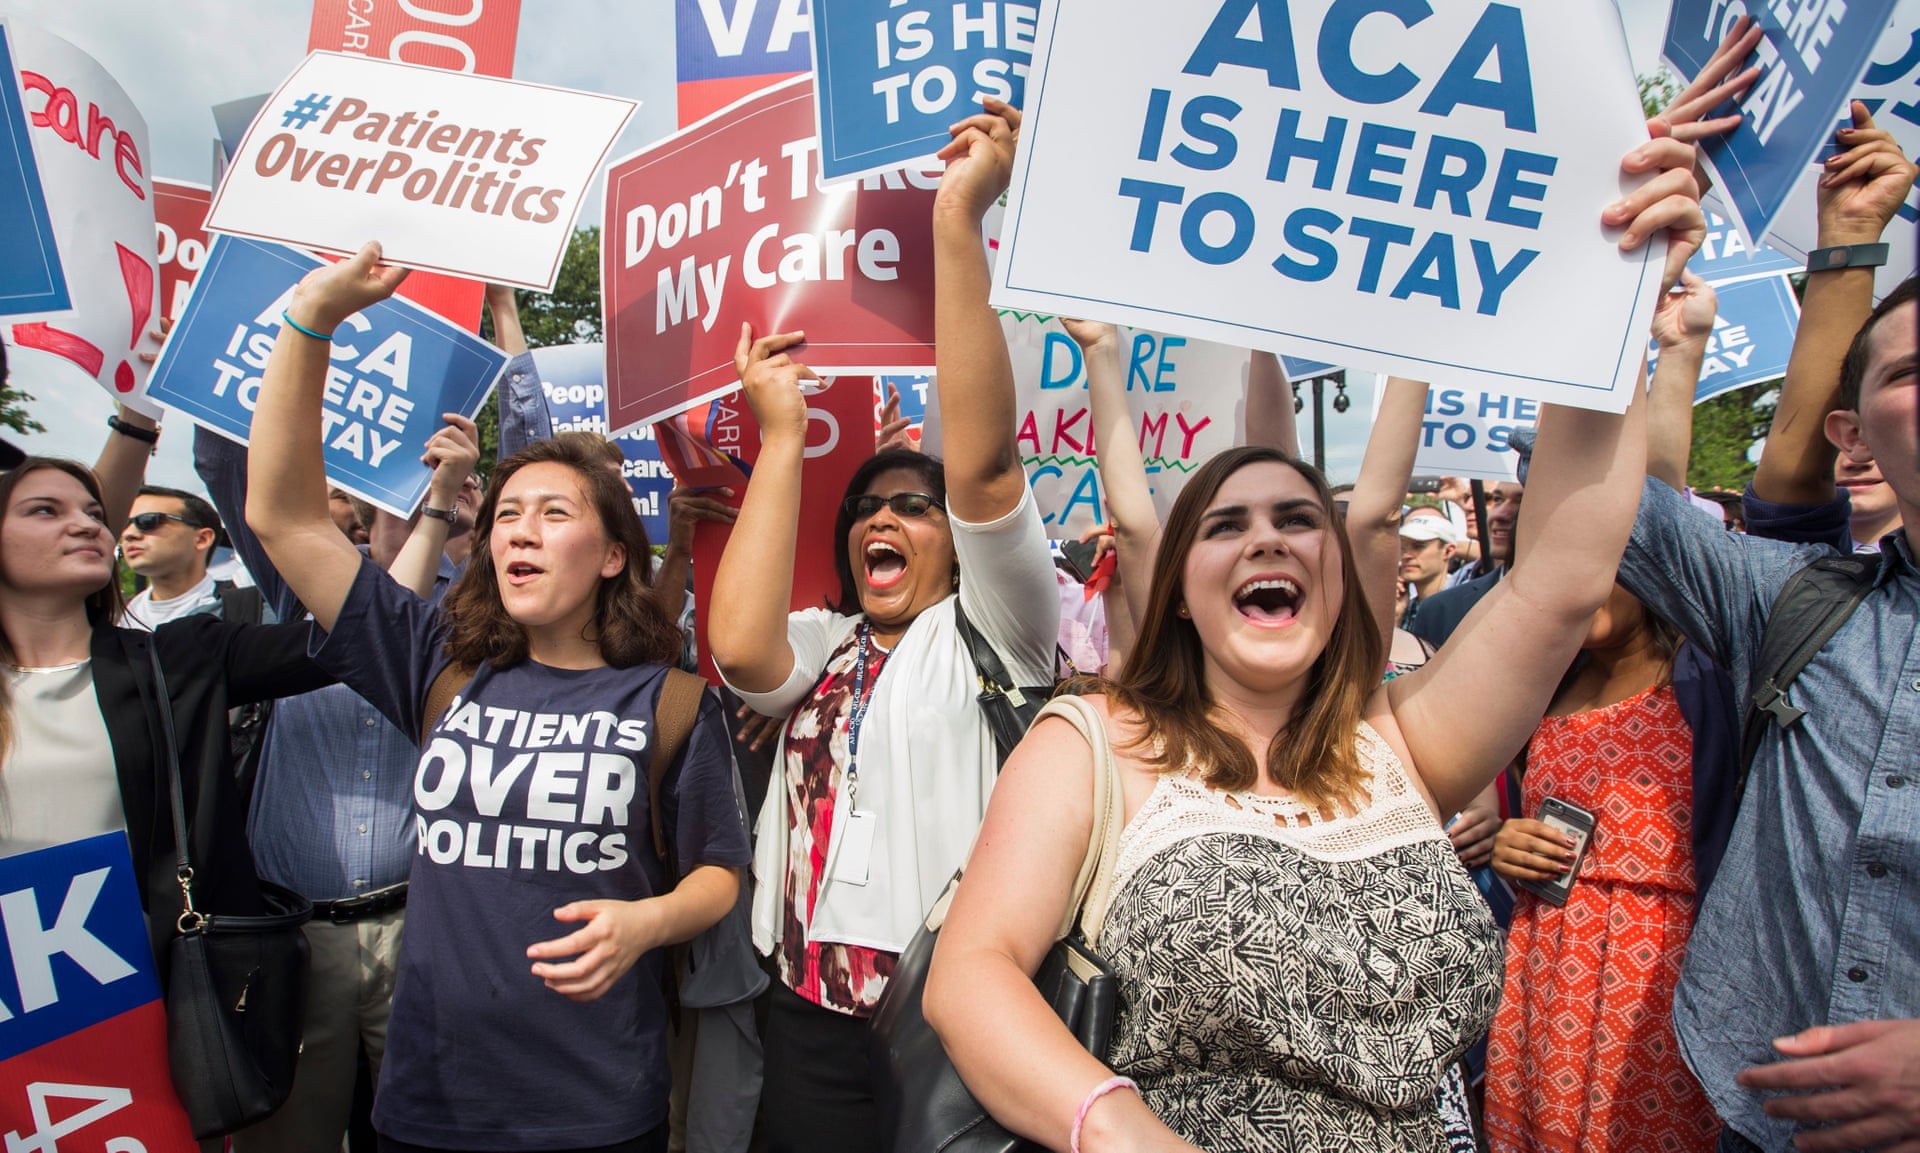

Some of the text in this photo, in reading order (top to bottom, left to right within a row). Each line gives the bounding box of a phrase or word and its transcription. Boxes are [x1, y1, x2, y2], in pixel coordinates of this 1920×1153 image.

[876, 10, 934, 69] IS
[1181, 0, 1537, 134] ACA
[872, 65, 957, 124] TO
[281, 92, 546, 169] #Patients
[1137, 87, 1559, 231] IS HERE
[254, 133, 567, 225] OverPolitics
[625, 160, 768, 268] Don’t
[1118, 177, 1541, 317] TO STAY
[655, 223, 900, 334] My Care
[225, 323, 273, 370] IS
[1040, 331, 1187, 392] DRE
[1139, 411, 1212, 460] MY
[1423, 421, 1476, 449] TO
[1424, 389, 1465, 416] IS
[436, 696, 647, 751] ATIENTS
[414, 737, 636, 826] OVER
